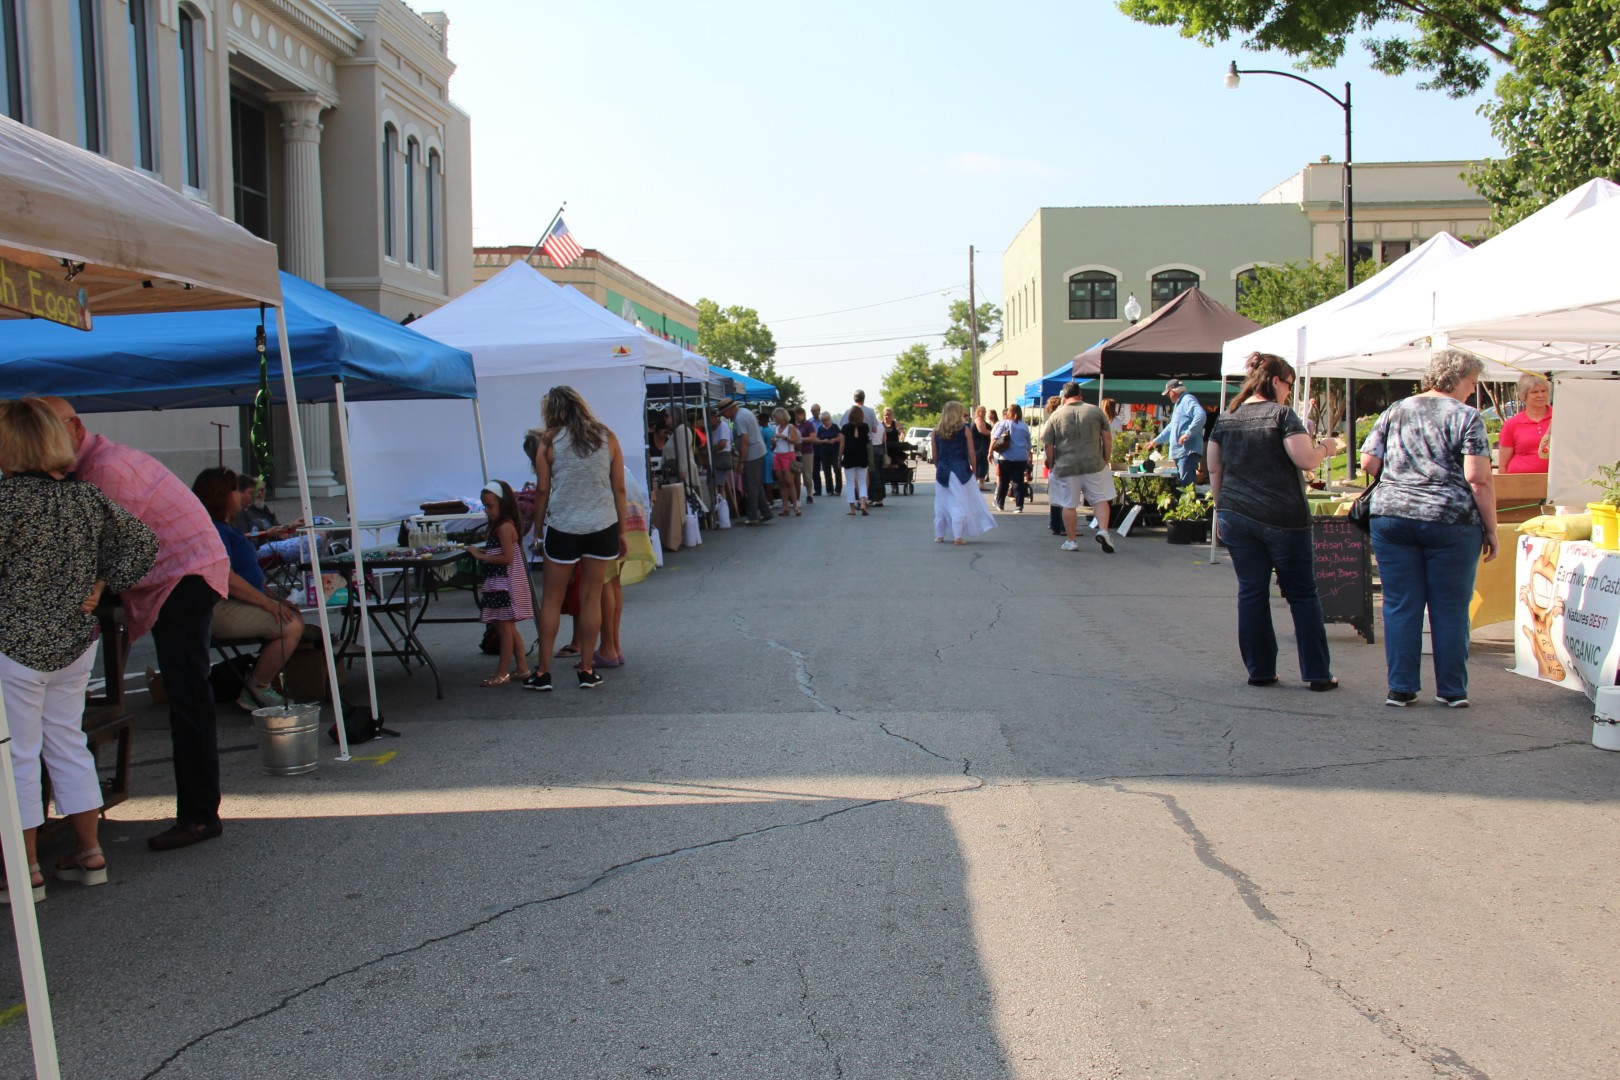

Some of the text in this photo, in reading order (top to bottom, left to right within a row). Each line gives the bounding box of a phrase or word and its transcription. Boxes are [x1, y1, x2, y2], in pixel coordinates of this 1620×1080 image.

[28, 269, 78, 327] Eggs
[1323, 523, 1353, 534] 11:11
[1344, 538, 1362, 549] Soap
[1338, 568, 1359, 579] Bars
[1557, 565, 1599, 590] Earthworm
[1567, 607, 1609, 630] Natures BEST!
[1565, 634, 1602, 666] ORGANIC
